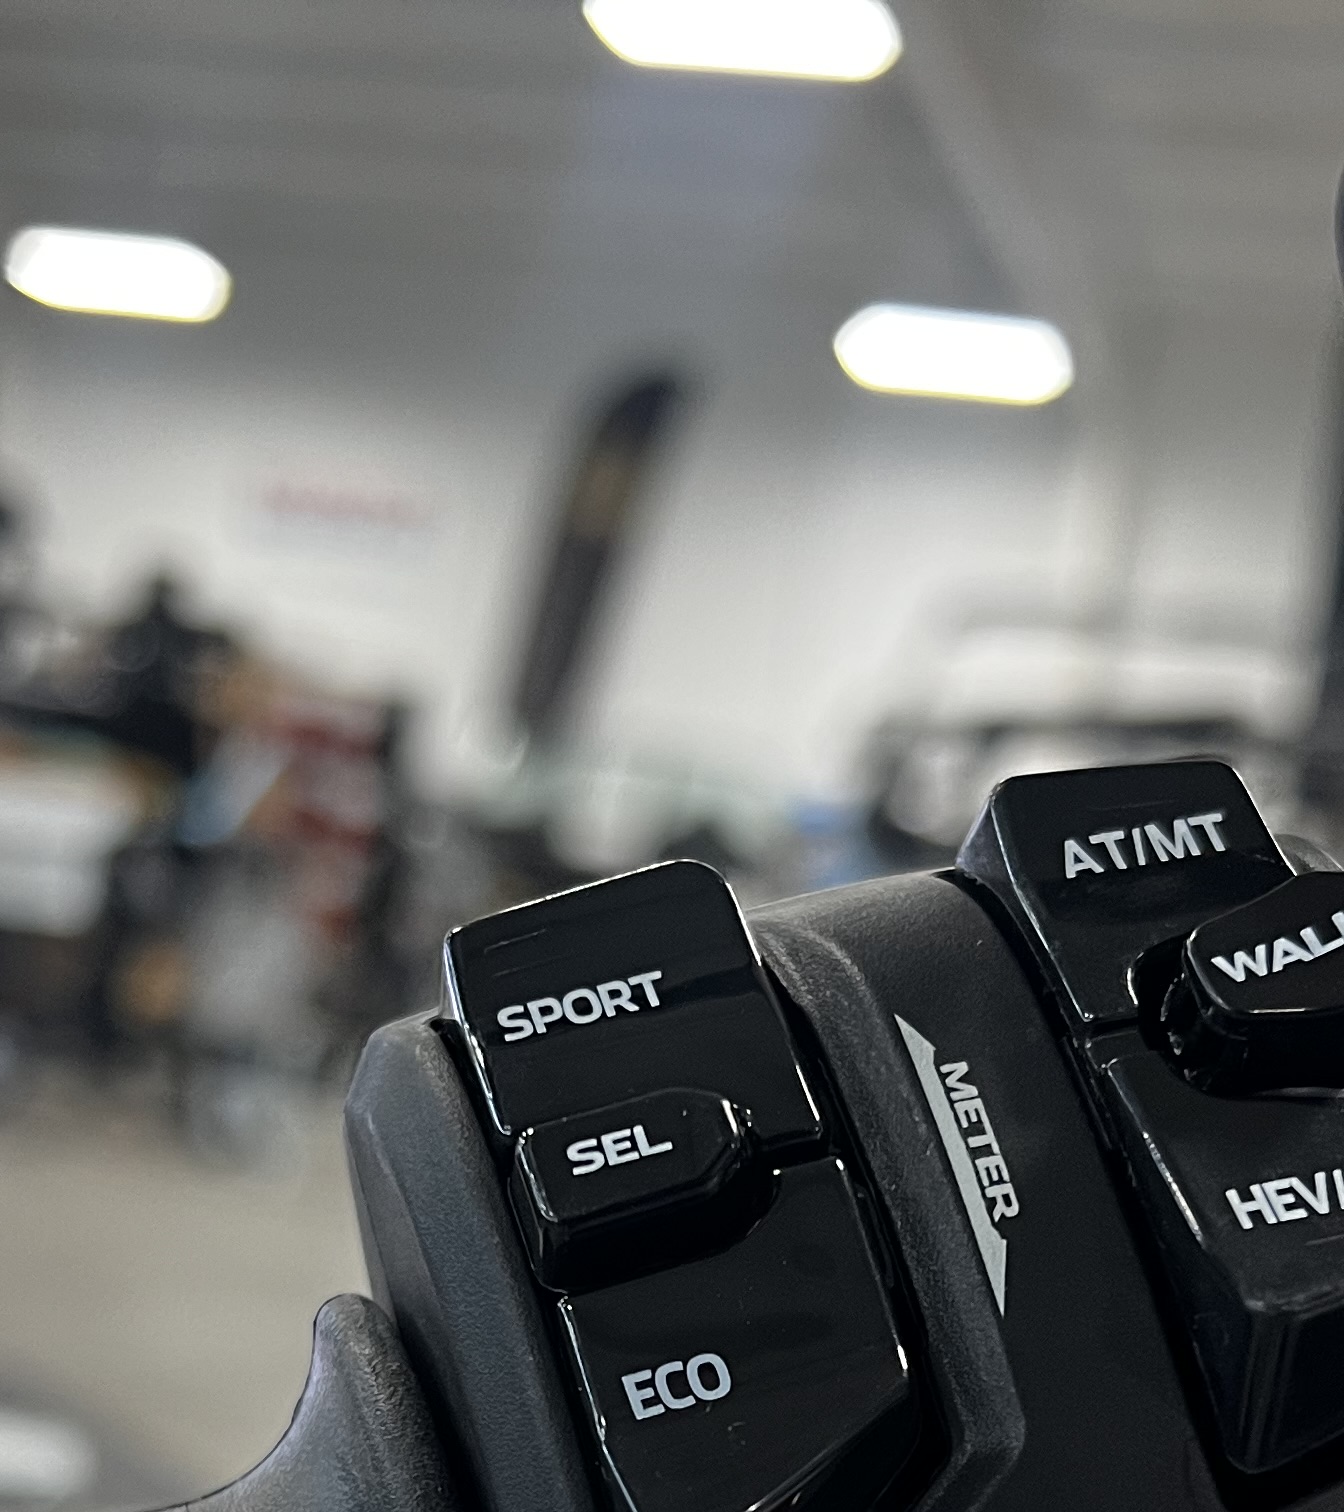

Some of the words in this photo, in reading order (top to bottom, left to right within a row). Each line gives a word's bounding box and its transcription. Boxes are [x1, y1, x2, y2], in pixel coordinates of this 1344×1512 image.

[1064, 812, 1226, 879] AT/MT
[496, 970, 662, 1042] SPORT
[566, 1124, 673, 1176] SEL
[939, 1060, 1019, 1223] METER
[621, 1353, 732, 1421] ECO
